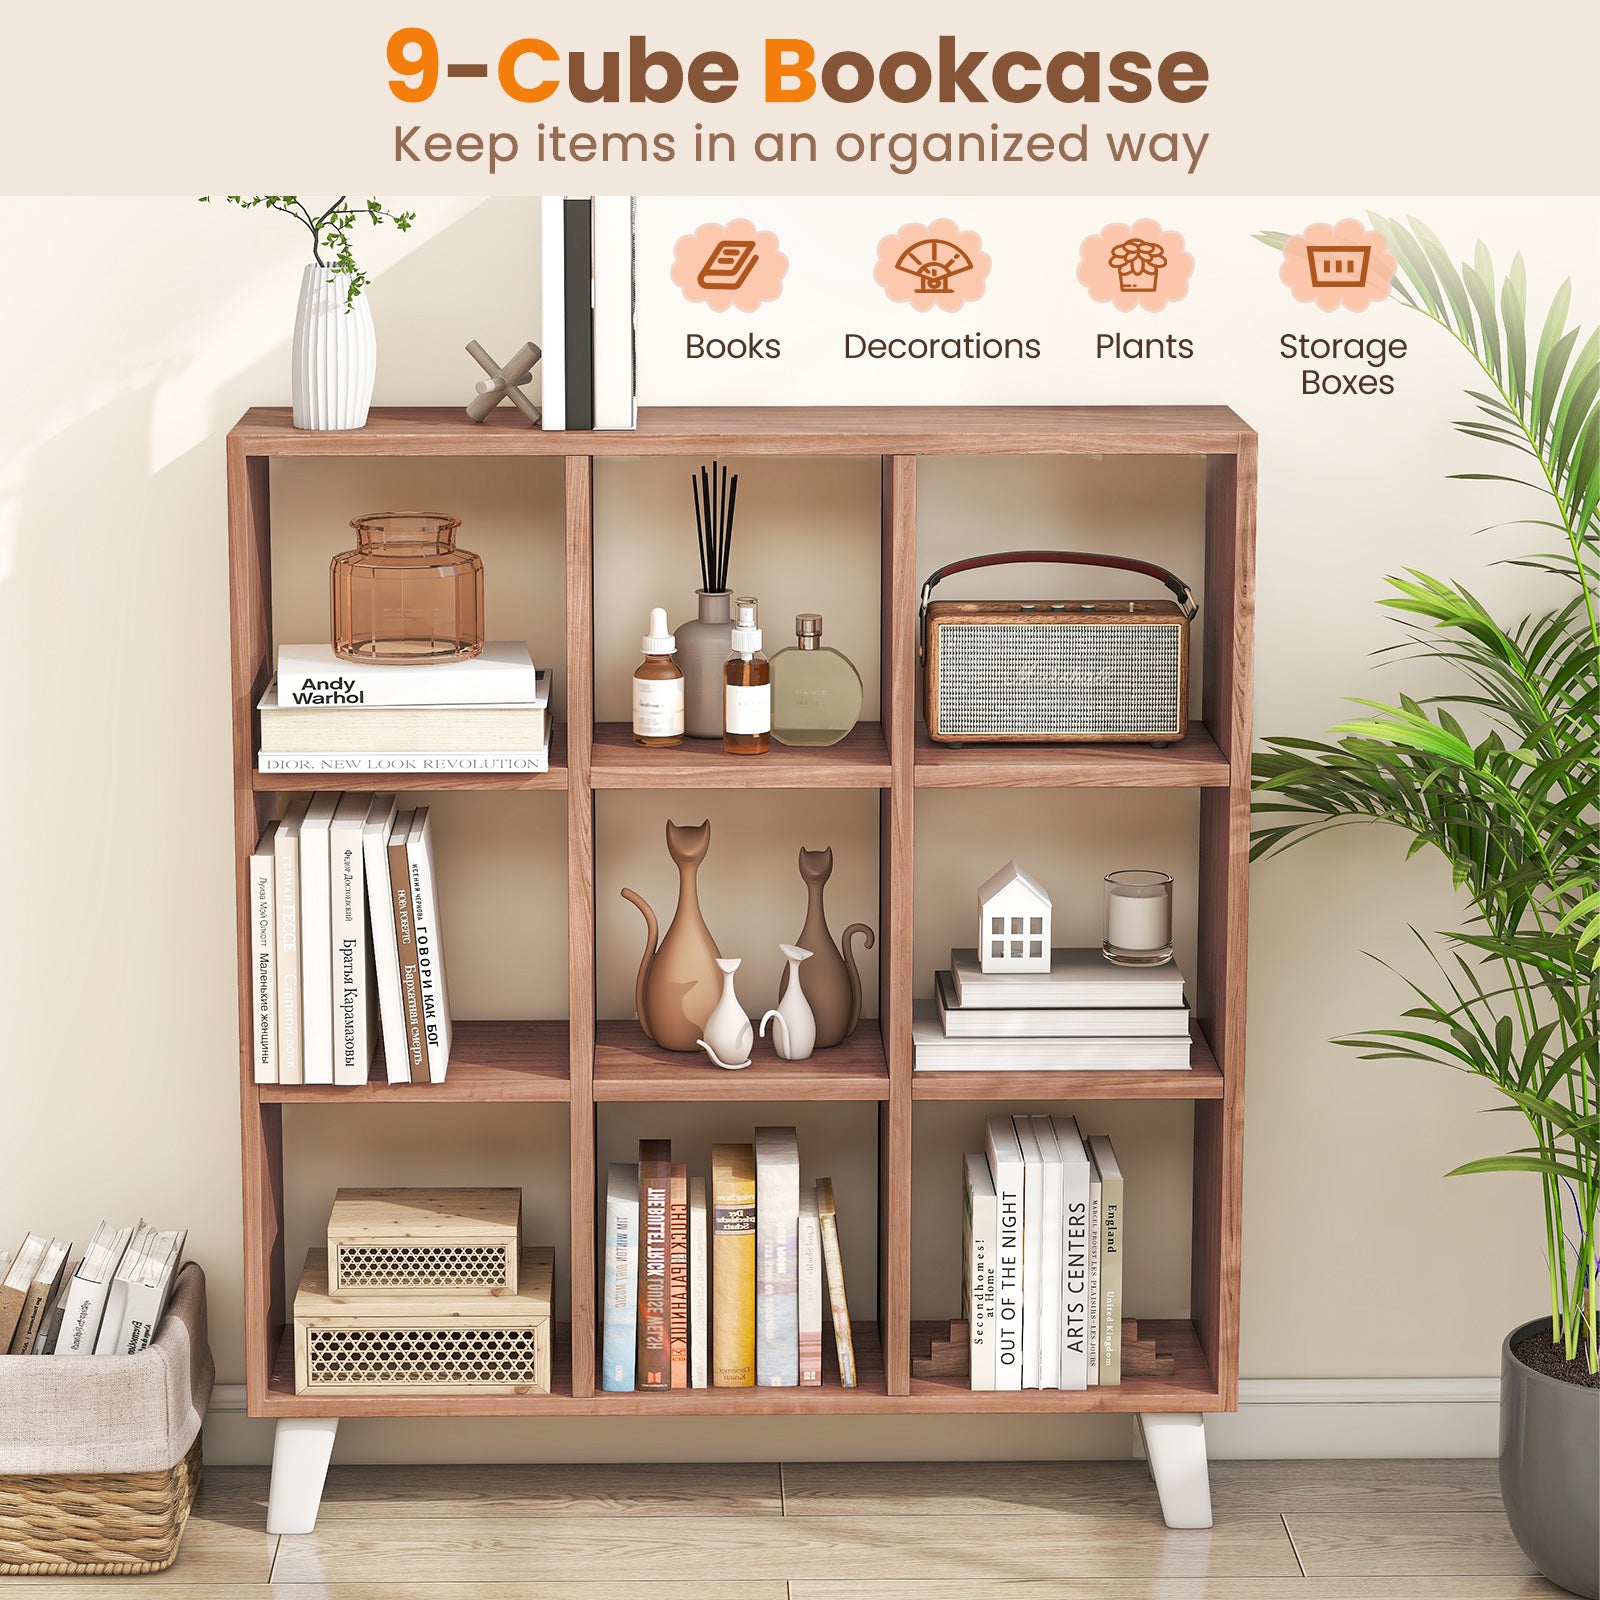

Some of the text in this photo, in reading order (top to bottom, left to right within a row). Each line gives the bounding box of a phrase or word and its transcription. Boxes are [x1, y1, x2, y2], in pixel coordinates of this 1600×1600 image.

[293, 692, 364, 704] Warhol
[302, 678, 355, 693] Andy
[267, 758, 539, 769] DIOR. NEW LOOK REVOLUTION
[259, 877, 267, 899] Луиза
[398, 889, 407, 909] НОРА
[412, 864, 420, 891] КСЕНИЯ
[260, 920, 268, 946] Олкотт
[282, 905, 296, 952] ГЕССЕ
[259, 953, 270, 1064] Маленькие женщины
[283, 974, 297, 1034] Степной
[339, 939, 357, 1067] Братья Карамазовы
[417, 927, 439, 1047] ГОВОРИ КАК БОГ
[403, 965, 423, 1065] Бархатная смерть
[1105, 1205, 1117, 1253] England
[974, 1240, 984, 1345] Secondhomes!
[985, 1268, 994, 1318] at Home
[1001, 1192, 1017, 1365] OUT OF THE NIGHT
[1067, 1203, 1085, 1353] ARTS CENTERS
[1105, 1291, 1114, 1366] United Kingdom
